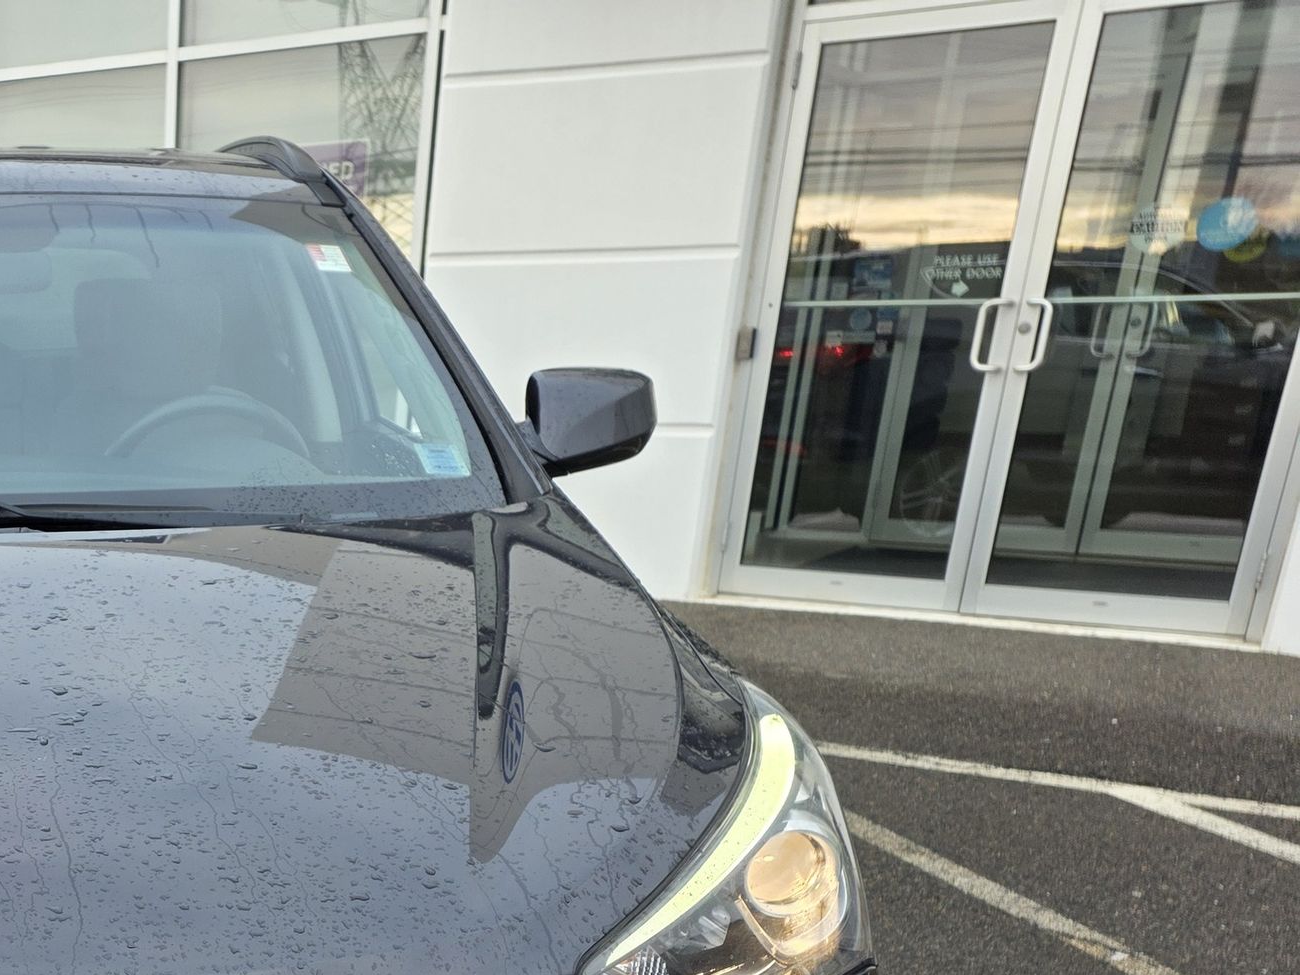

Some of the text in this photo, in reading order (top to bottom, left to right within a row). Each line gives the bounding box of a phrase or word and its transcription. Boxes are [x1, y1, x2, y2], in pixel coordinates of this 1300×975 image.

[933, 253, 1000, 268] PLEASE USE
[925, 267, 1003, 280] OTHER DOOR
